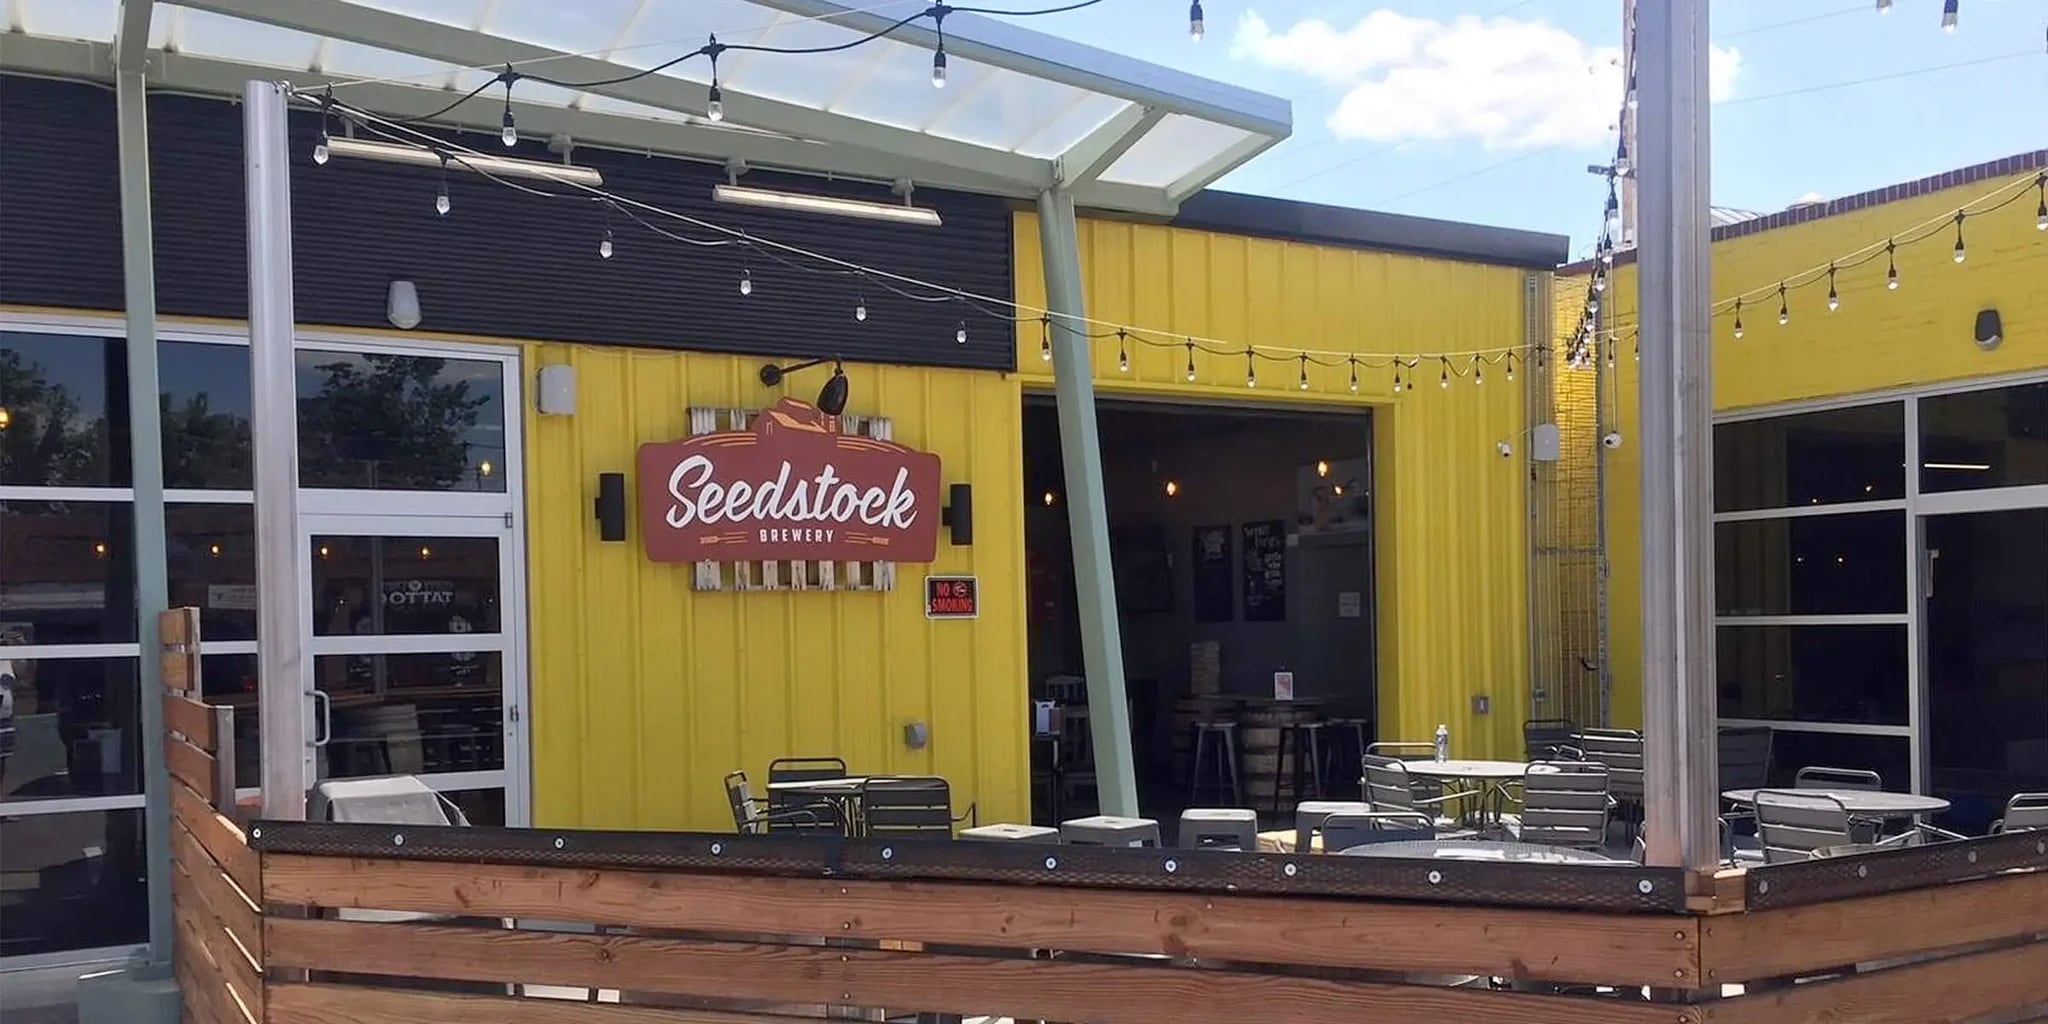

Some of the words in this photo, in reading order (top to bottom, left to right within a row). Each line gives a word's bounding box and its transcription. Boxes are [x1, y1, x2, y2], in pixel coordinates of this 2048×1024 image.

[666, 455, 917, 529] Seedstock
[759, 528, 835, 543] BREWERY
[937, 583, 950, 597] NO
[932, 597, 973, 612] SMOKING
